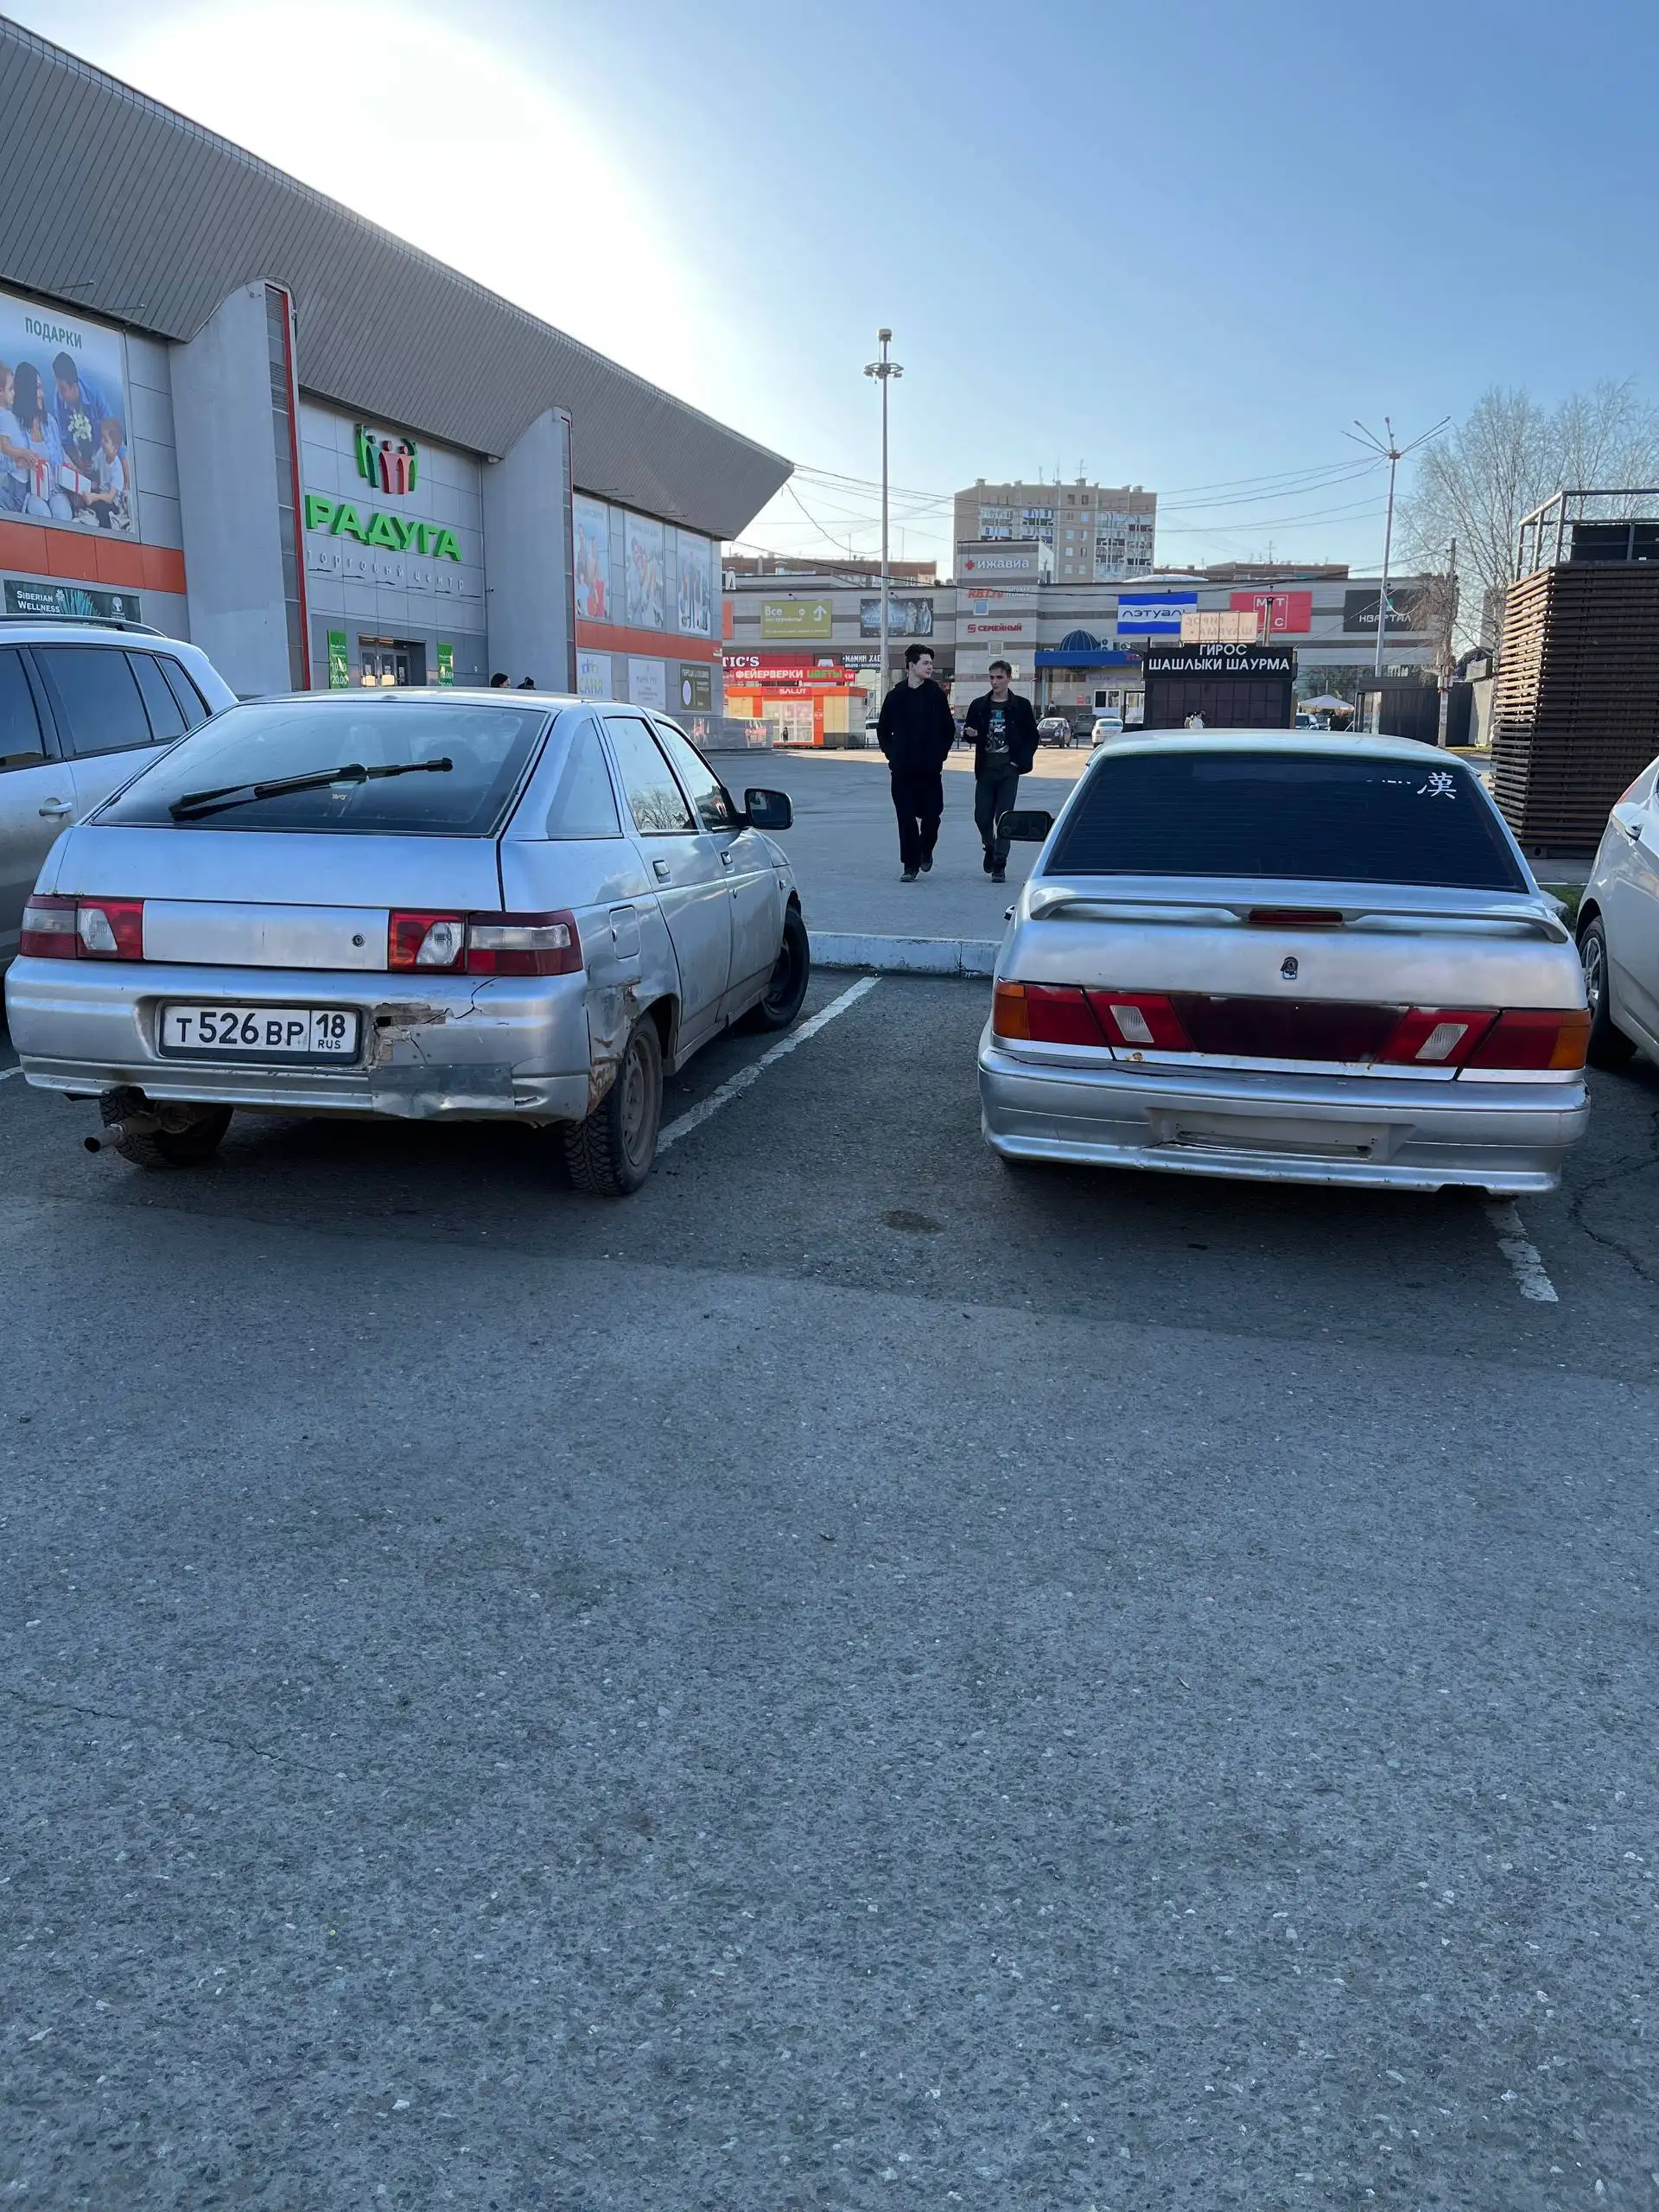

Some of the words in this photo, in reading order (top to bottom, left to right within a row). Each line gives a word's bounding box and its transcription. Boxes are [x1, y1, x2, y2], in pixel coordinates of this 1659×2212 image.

[24, 316, 82, 349] ПОДАРКИ
[305, 494, 462, 562] РАДУГА
[977, 559, 1029, 569] ижавиа
[16, 590, 54, 603] SIBERIAN
[17, 601, 60, 613] WELLNESS
[765, 606, 783, 616] Все
[977, 623, 1022, 632] СЕМЕЙНЫЙ
[1199, 644, 1247, 656] ГИРОС
[1148, 658, 1222, 671] ШАШЛЫКИ
[1226, 658, 1289, 671] ШАУРМА
[735, 668, 804, 679] ФЕЙЕРВЕРКИ
[316, 1014, 346, 1039] 18
[318, 1039, 341, 1050] RUS
